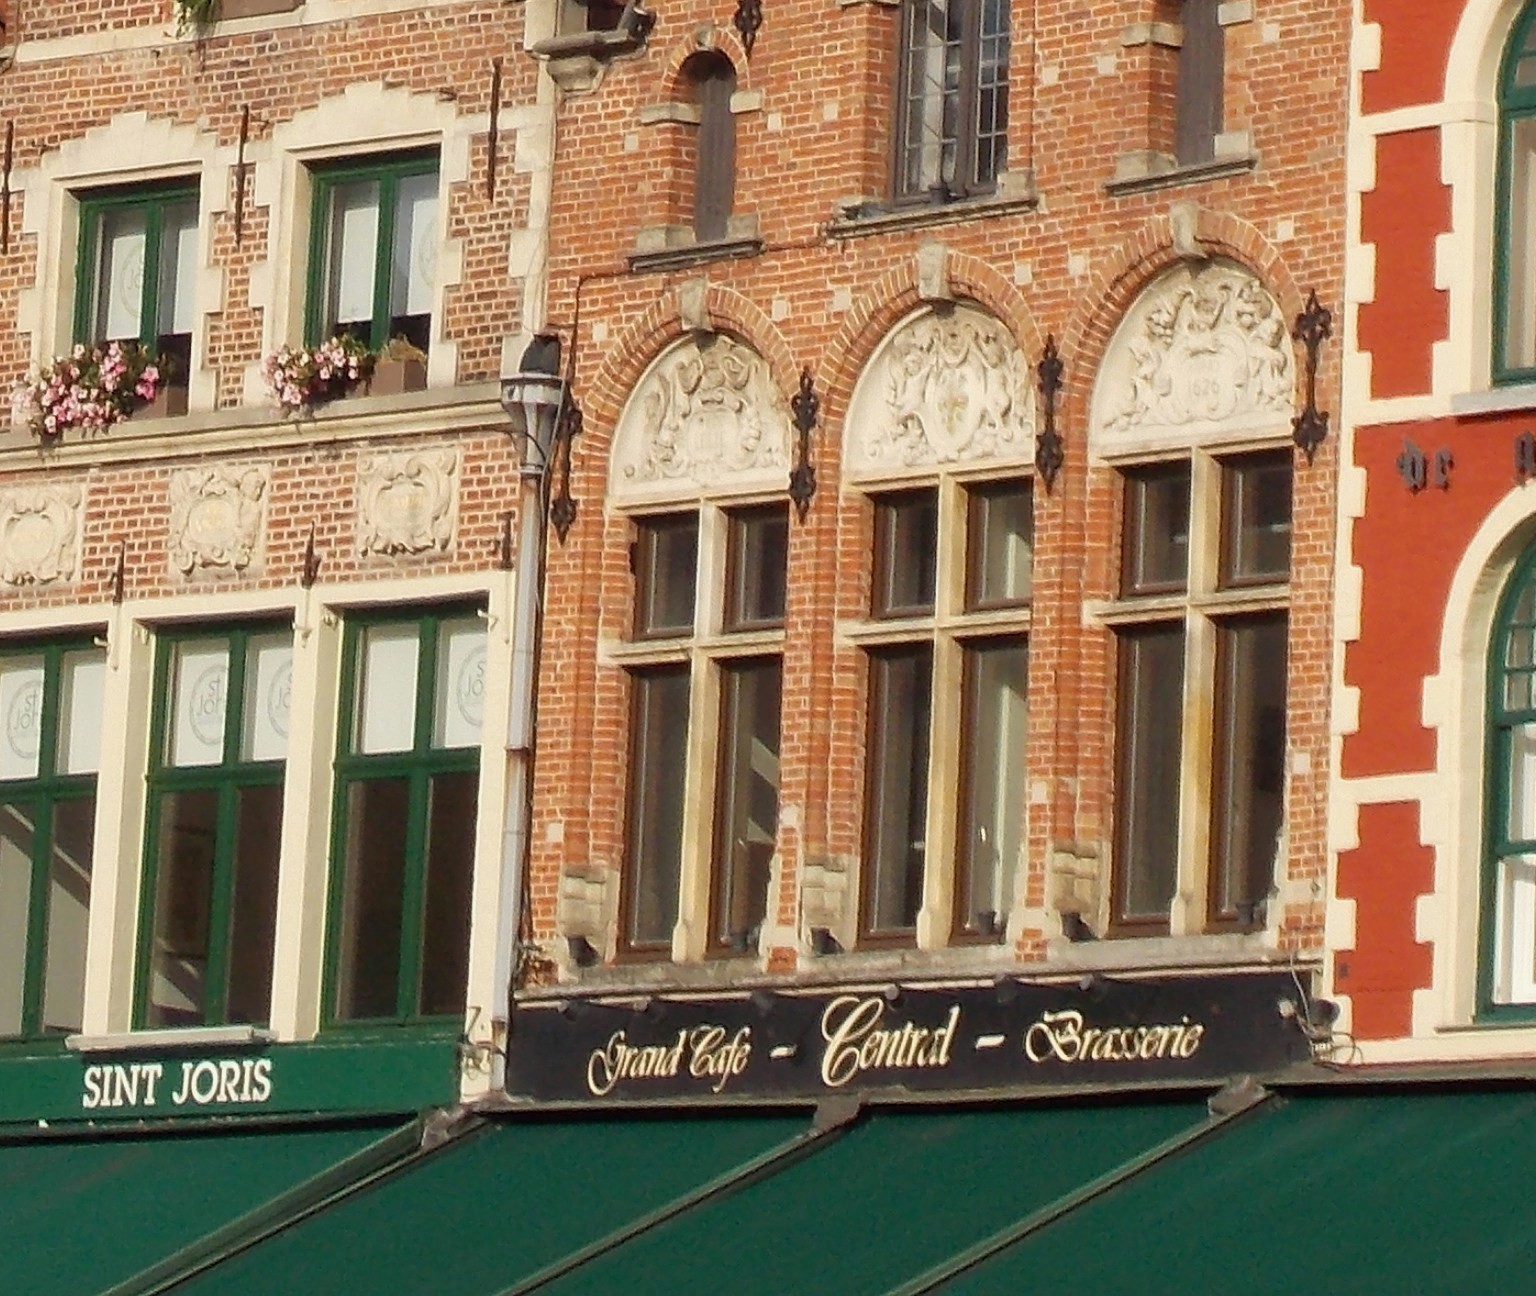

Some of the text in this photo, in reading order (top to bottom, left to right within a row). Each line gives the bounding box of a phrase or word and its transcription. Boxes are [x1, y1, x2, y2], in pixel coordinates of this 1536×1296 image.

[82, 1058, 272, 1109] SINT JORIS
[588, 1030, 688, 1096] Grand
[821, 995, 960, 1087] Central
[1025, 1010, 1204, 1063] Brasserie
